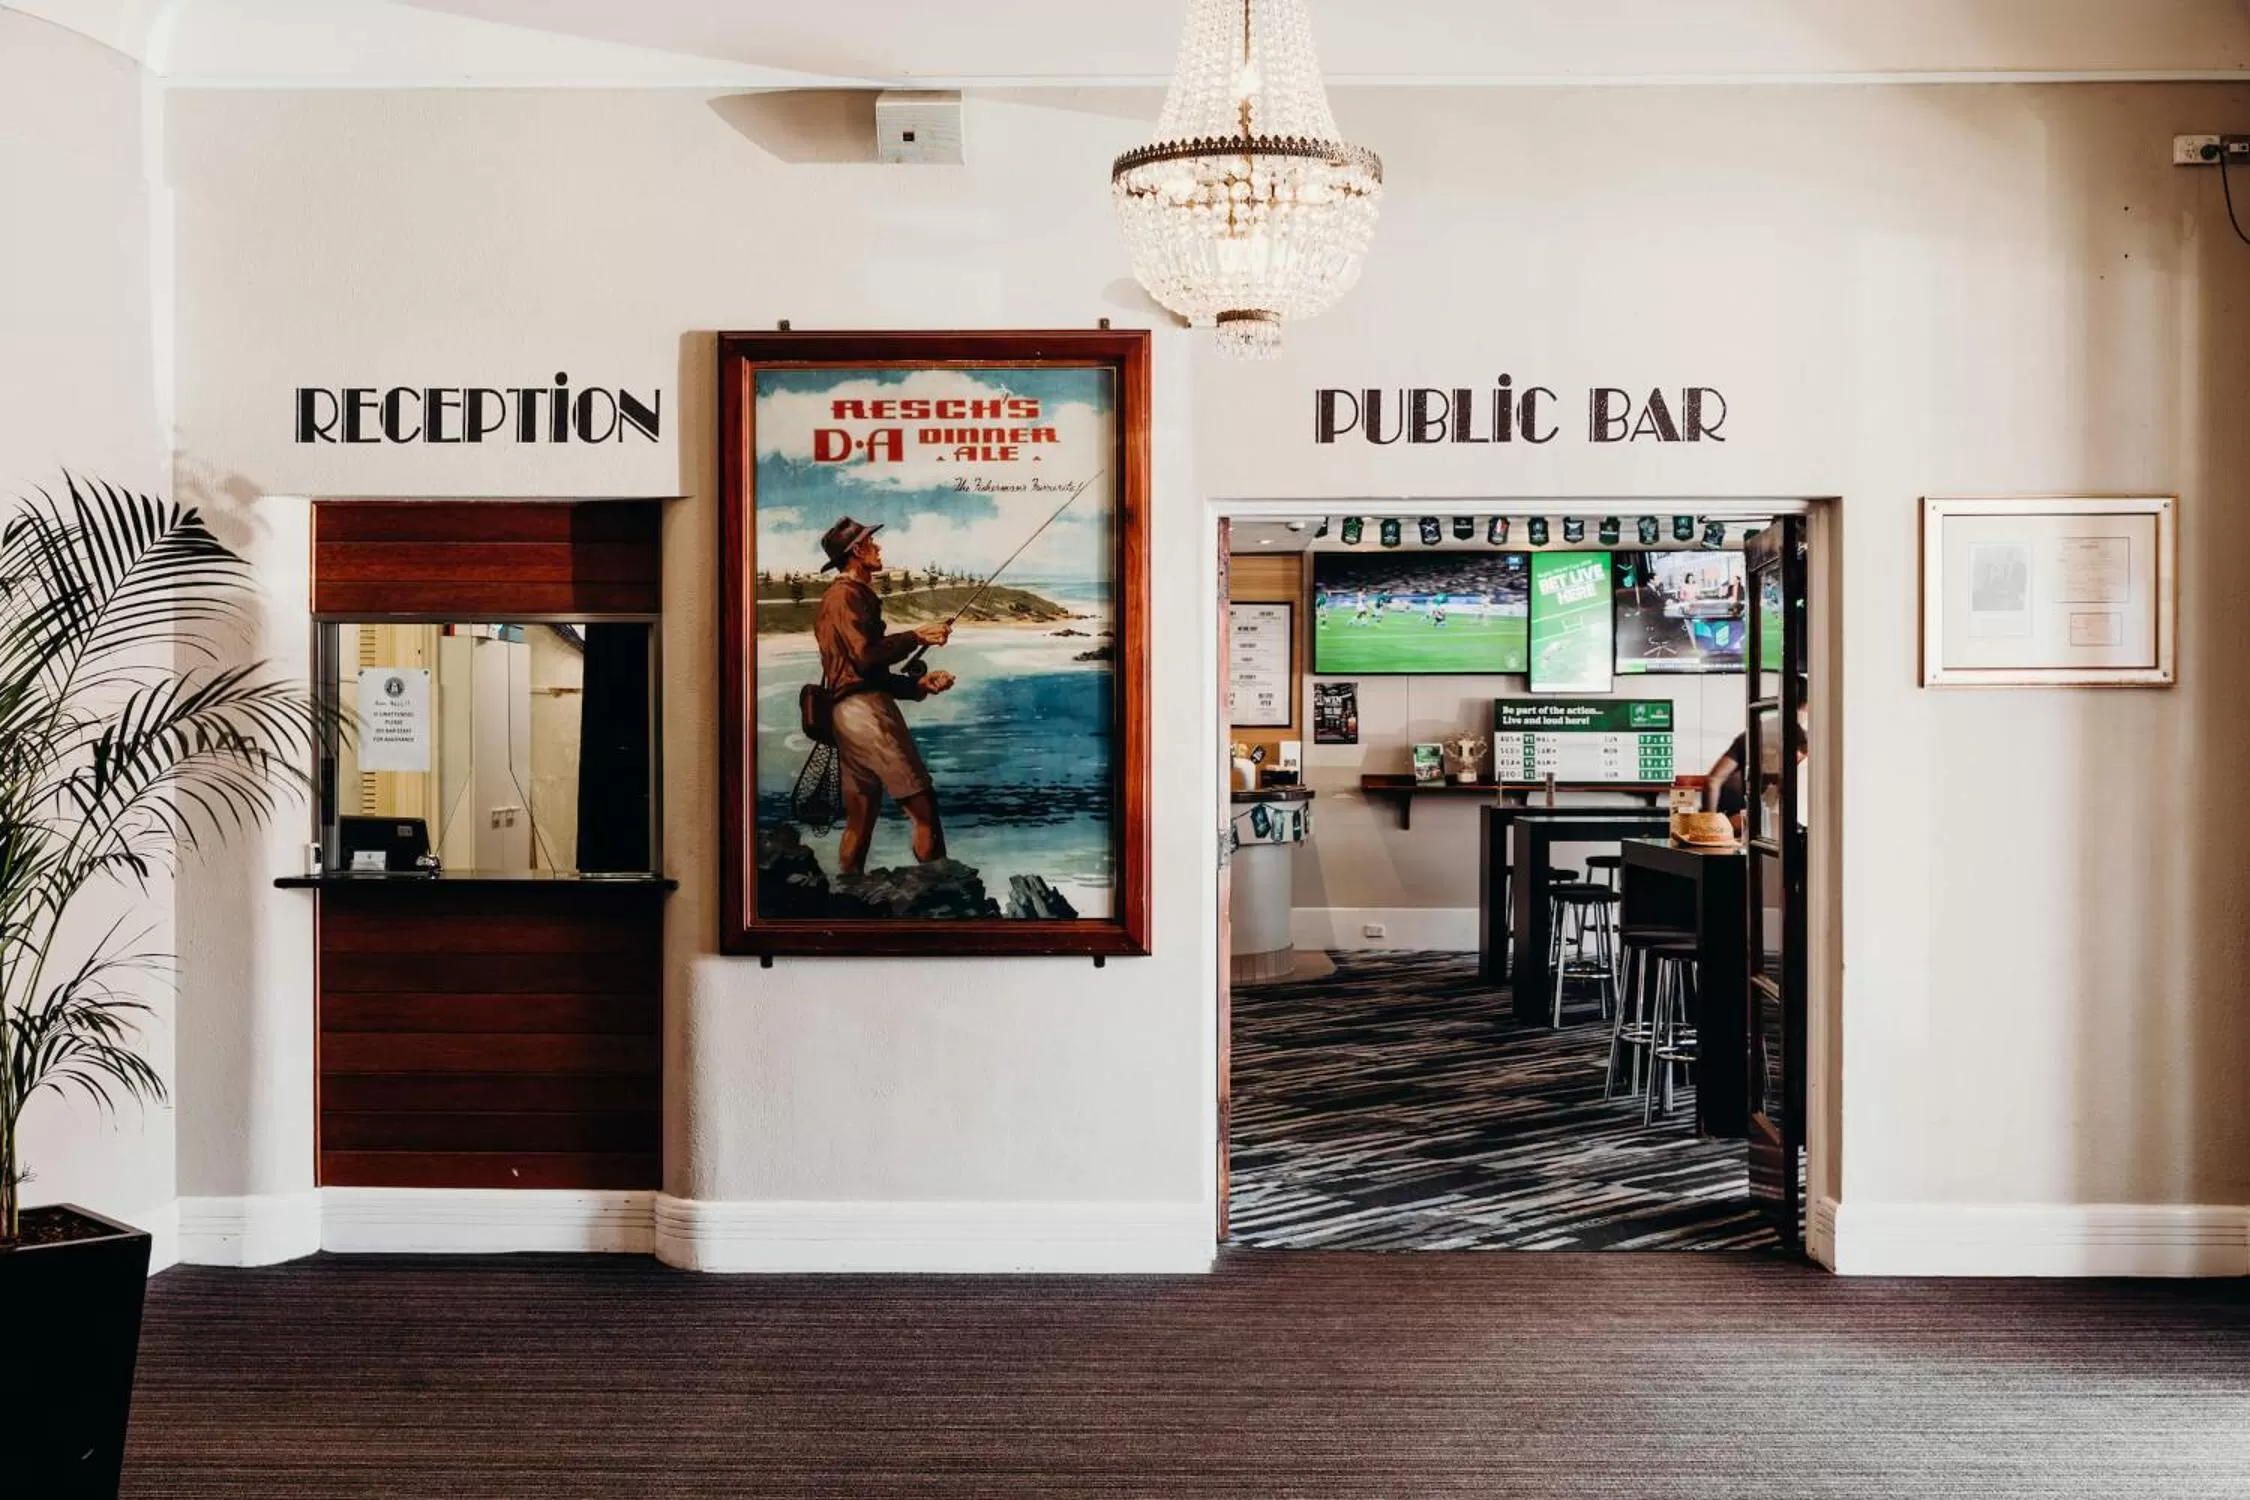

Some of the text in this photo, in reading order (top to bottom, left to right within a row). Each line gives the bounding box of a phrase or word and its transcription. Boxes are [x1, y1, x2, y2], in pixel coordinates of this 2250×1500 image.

[831, 393, 1040, 420] RESCH'S
[1588, 386, 1727, 443] BAR
[918, 427, 1061, 444] DINNER
[953, 446, 1020, 462] ALE
[953, 477, 970, 492] The
[1538, 573, 1567, 596] BET
[1568, 563, 1605, 585] LIVE
[1502, 705, 1514, 715] Be
[1516, 706, 1537, 717] part
[1538, 705, 1549, 715] of
[1549, 705, 1566, 715] the
[1502, 715, 1590, 725] Live and loud here!
